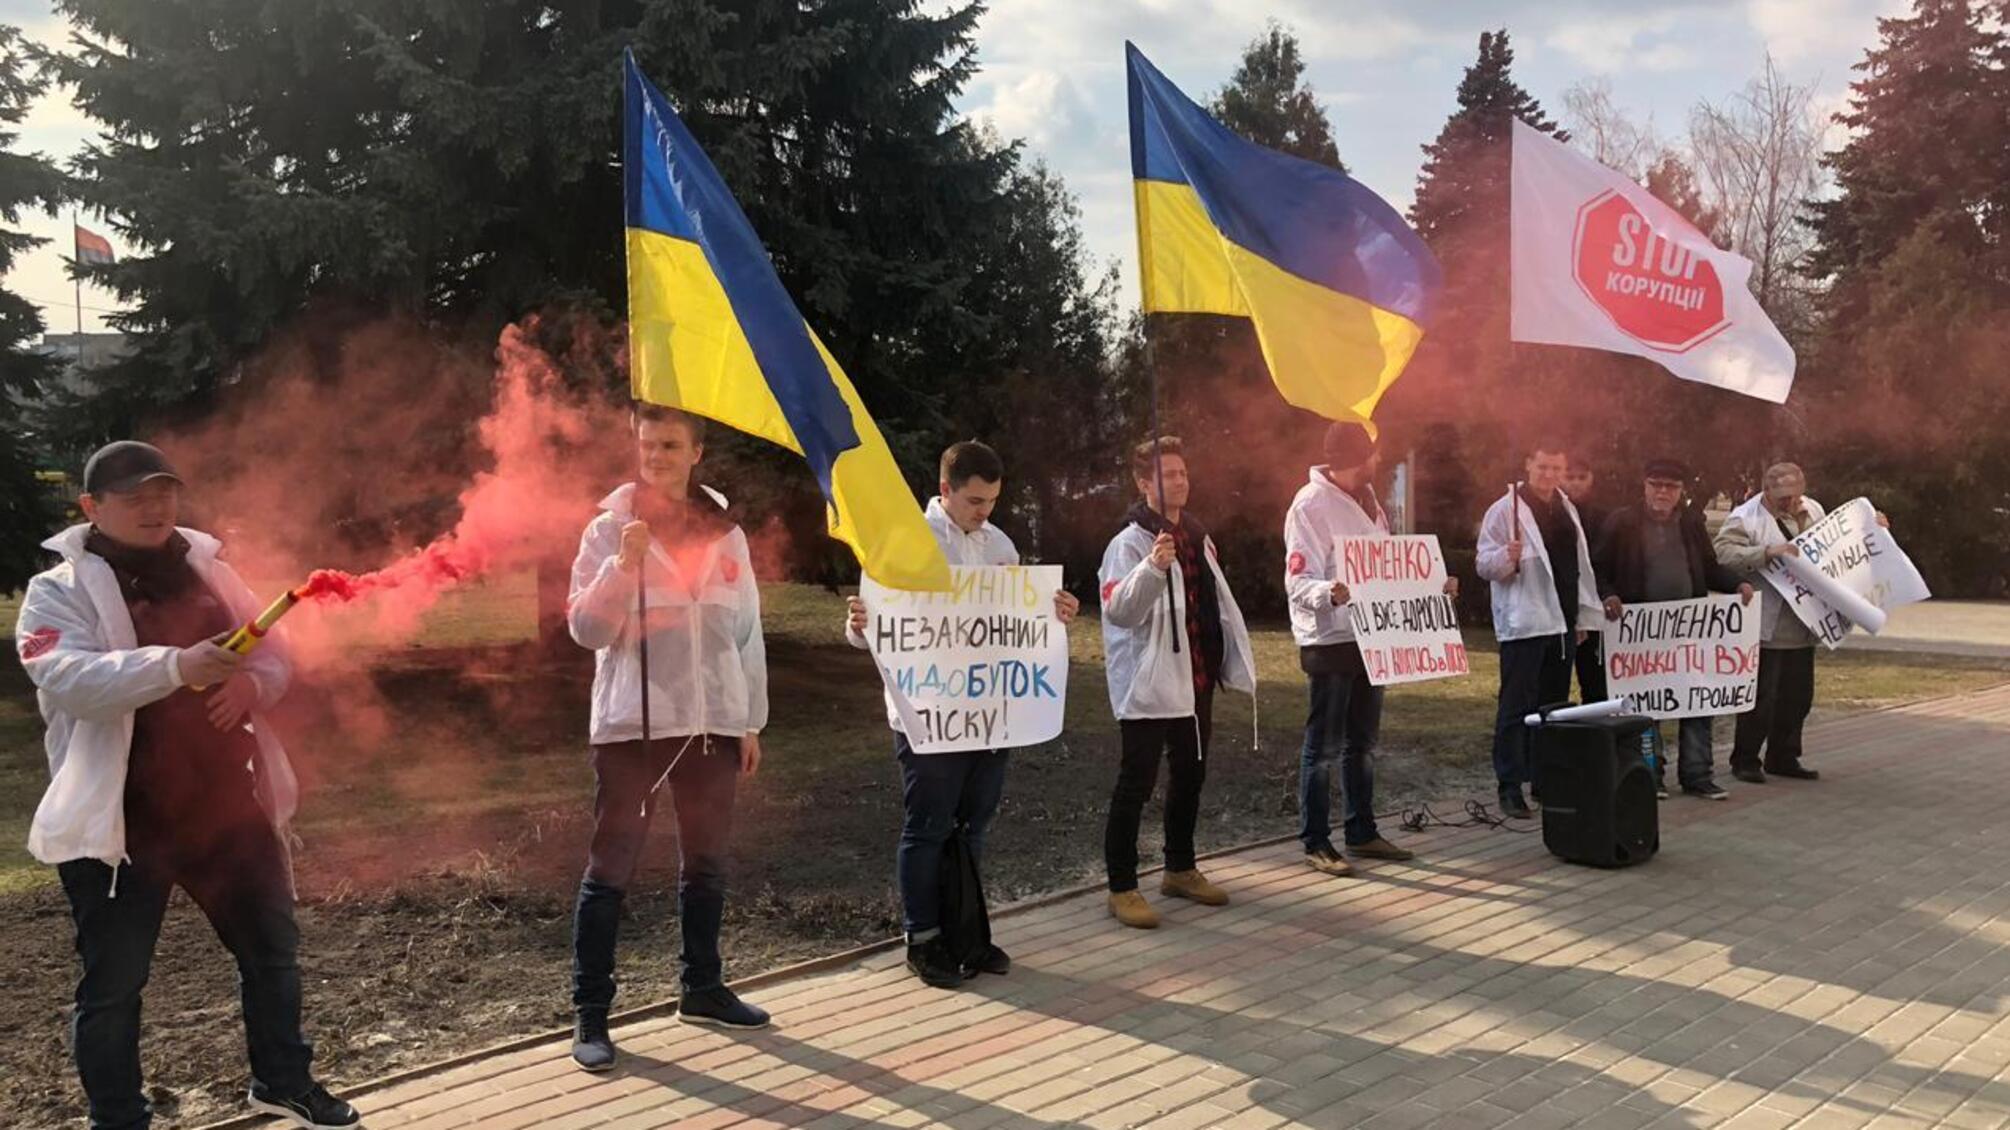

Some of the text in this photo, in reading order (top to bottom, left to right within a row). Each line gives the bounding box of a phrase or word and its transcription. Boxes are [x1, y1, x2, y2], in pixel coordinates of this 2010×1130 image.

[1605, 270, 1706, 312] КОРУПЦІЇ
[1802, 512, 1853, 564] ВАШЕ
[884, 566, 1038, 612] ИНІТЬ
[876, 613, 1049, 653] НЕЗАКОННИЙ
[1619, 602, 1743, 644] КЛИМЕНКО
[884, 660, 1058, 699] ИДОБУТОК
[1610, 643, 1760, 680] СКІЛЬКИ ТИ ВЖЕ
[1688, 679, 1756, 711] ГРОШЕЙ
